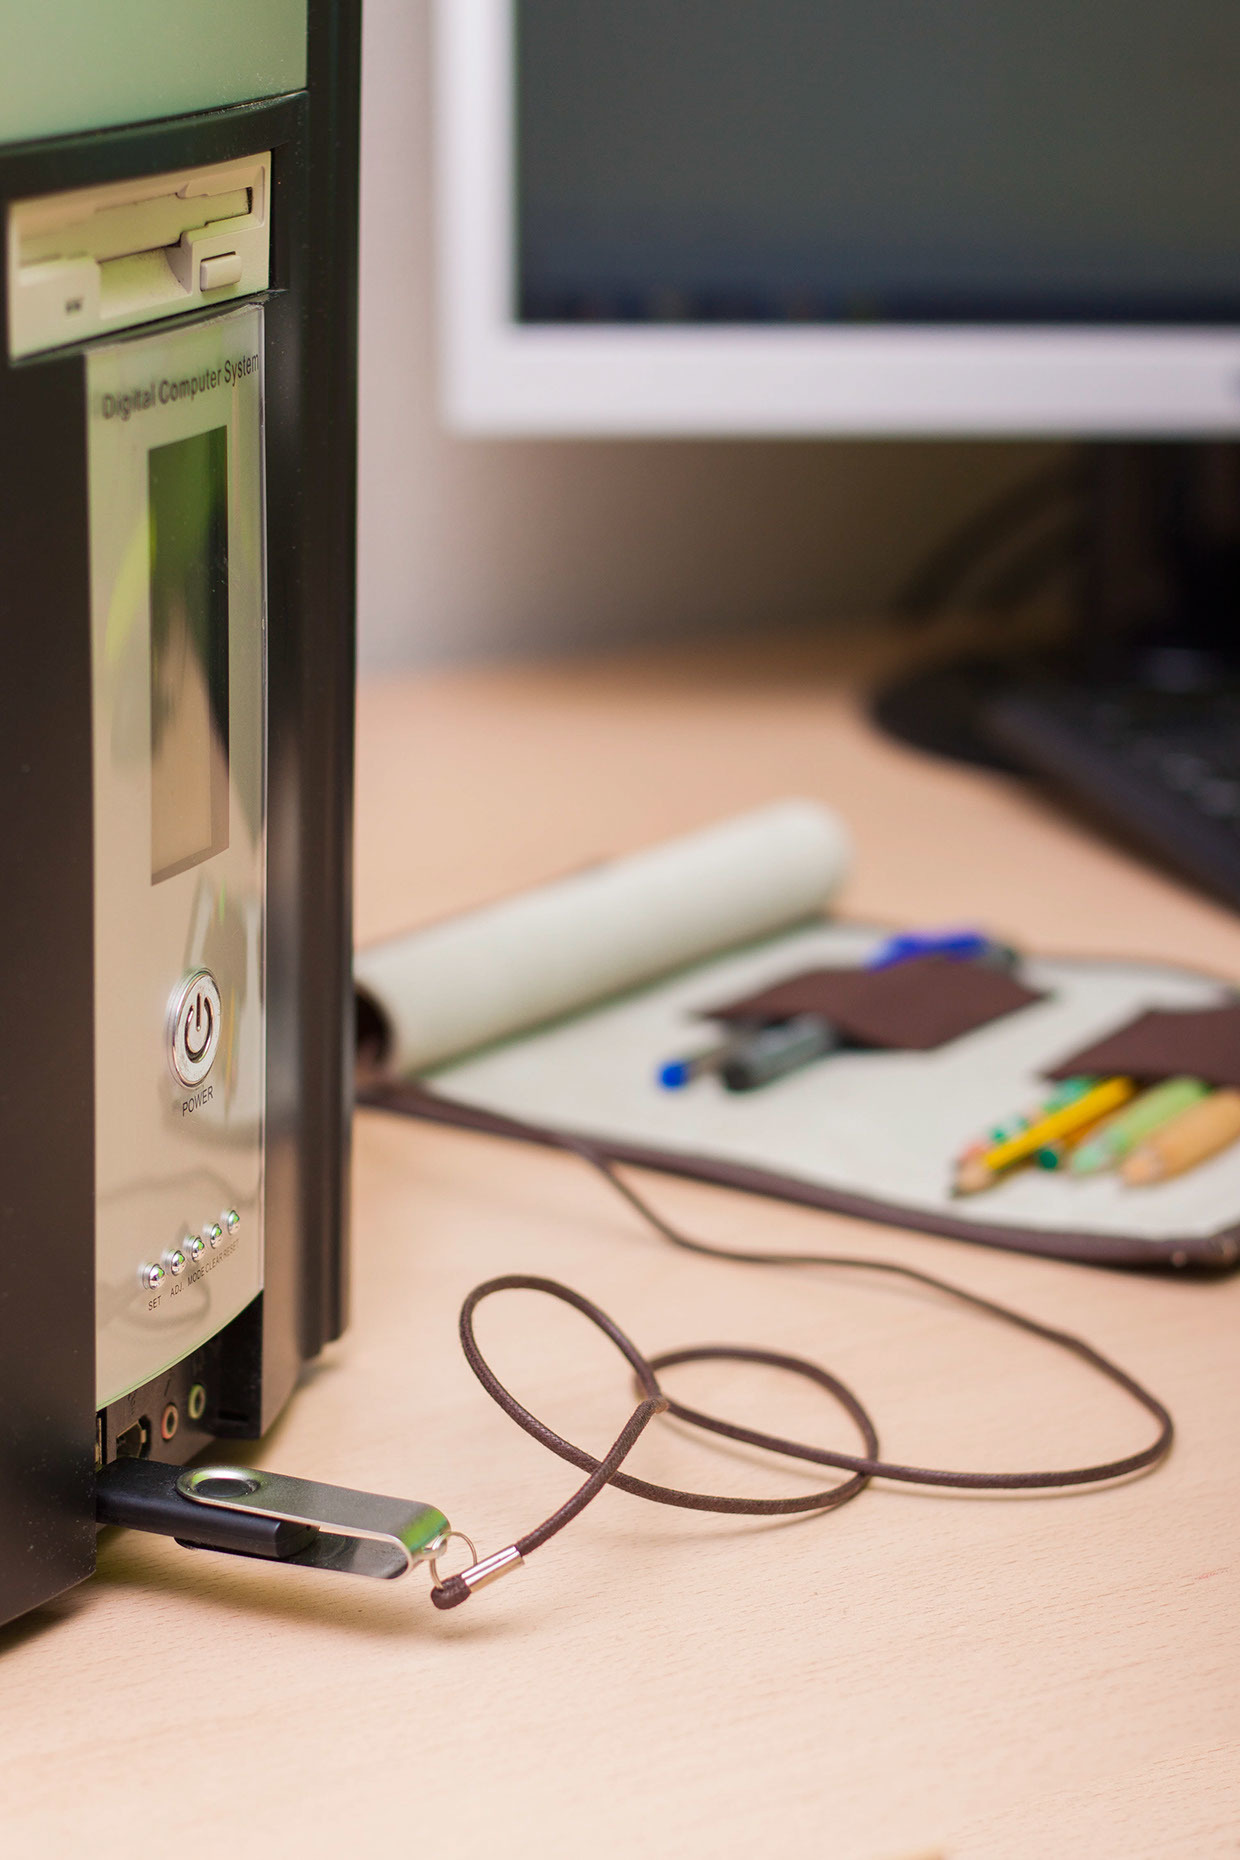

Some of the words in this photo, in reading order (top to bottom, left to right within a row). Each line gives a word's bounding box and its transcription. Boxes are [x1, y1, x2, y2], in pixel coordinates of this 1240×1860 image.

[103, 383, 156, 421] Digital
[158, 368, 222, 404] Computer
[224, 354, 259, 387] System
[183, 1086, 213, 1117] POWER
[148, 1295, 162, 1311] SET
[187, 1266, 205, 1286] MODE
